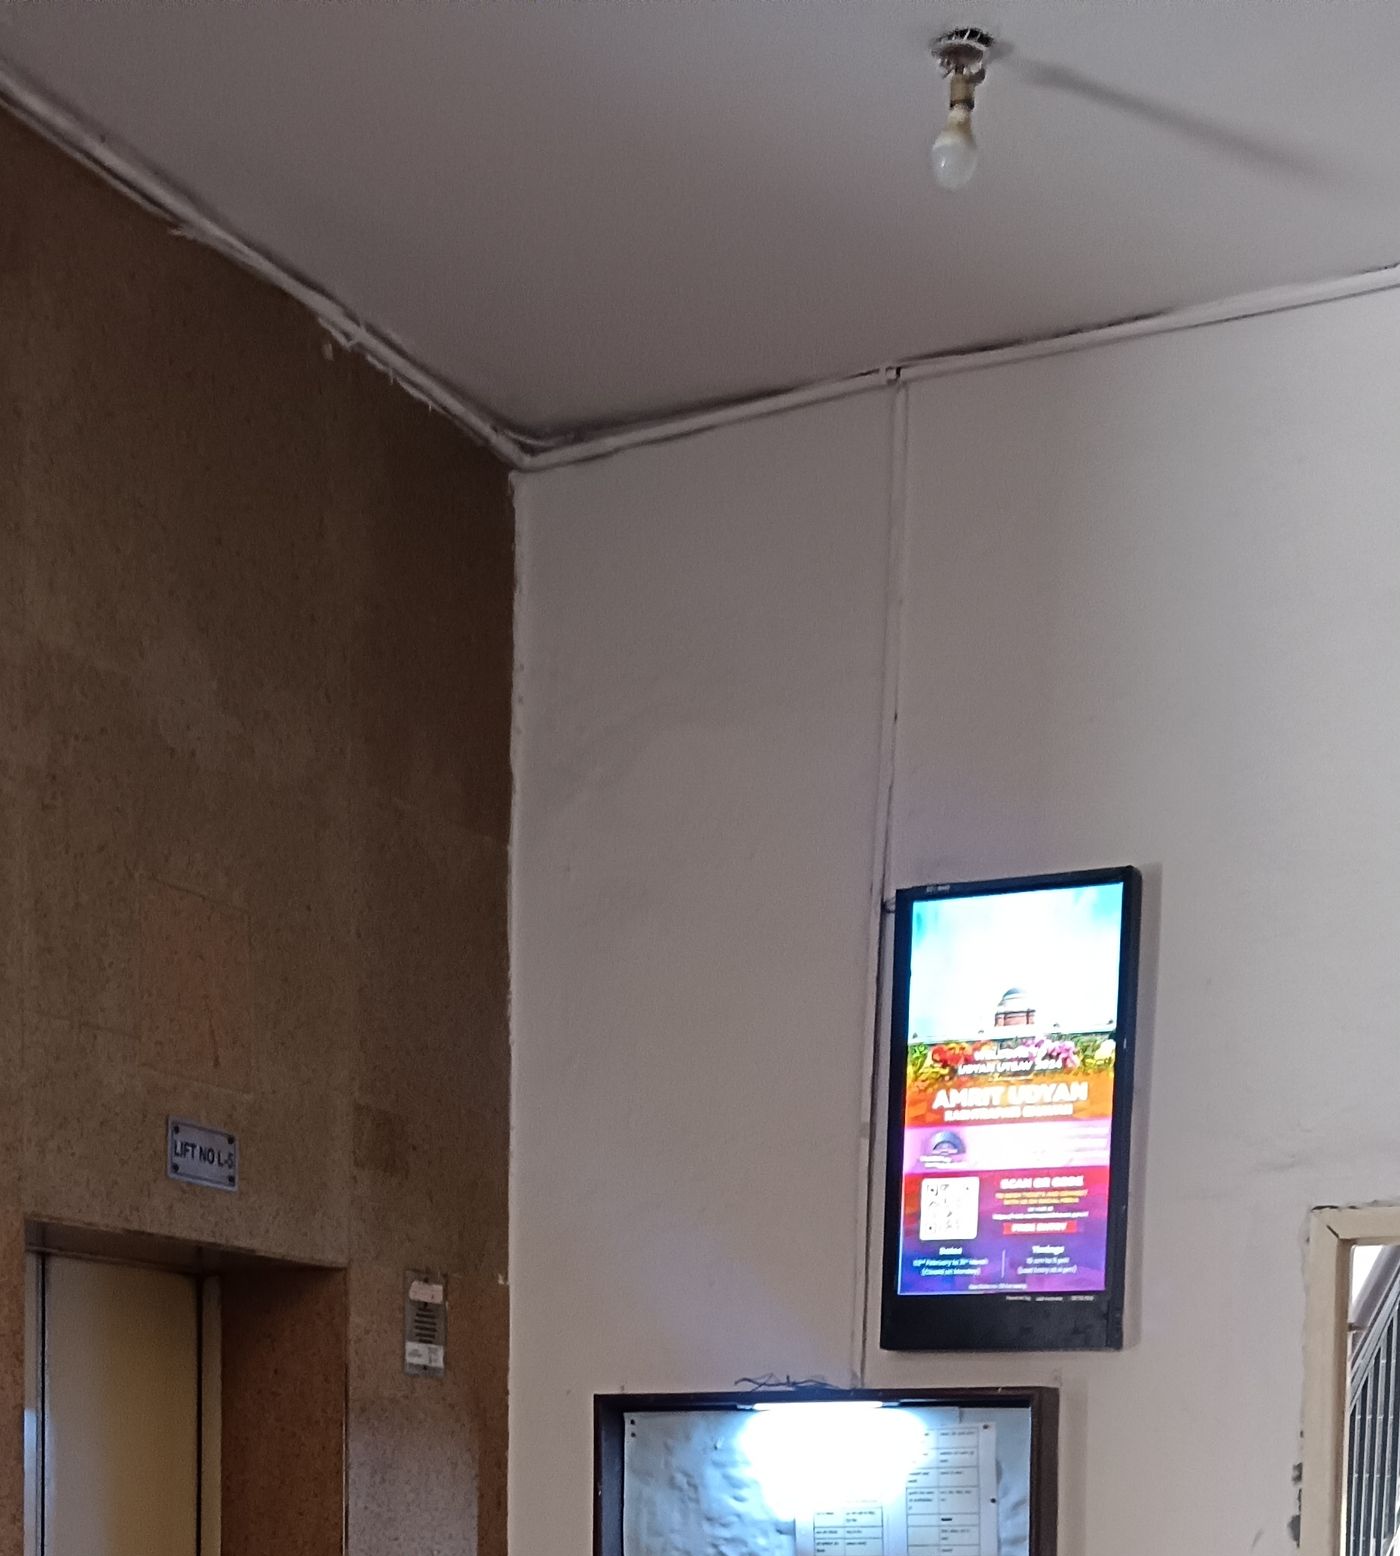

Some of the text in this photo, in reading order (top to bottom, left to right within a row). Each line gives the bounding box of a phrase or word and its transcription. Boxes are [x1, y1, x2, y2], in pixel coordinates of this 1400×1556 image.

[932, 1082, 1088, 1109] AMRIT UDYAN
[174, 1140, 197, 1159] LIFT
[199, 1145, 216, 1165] NO
